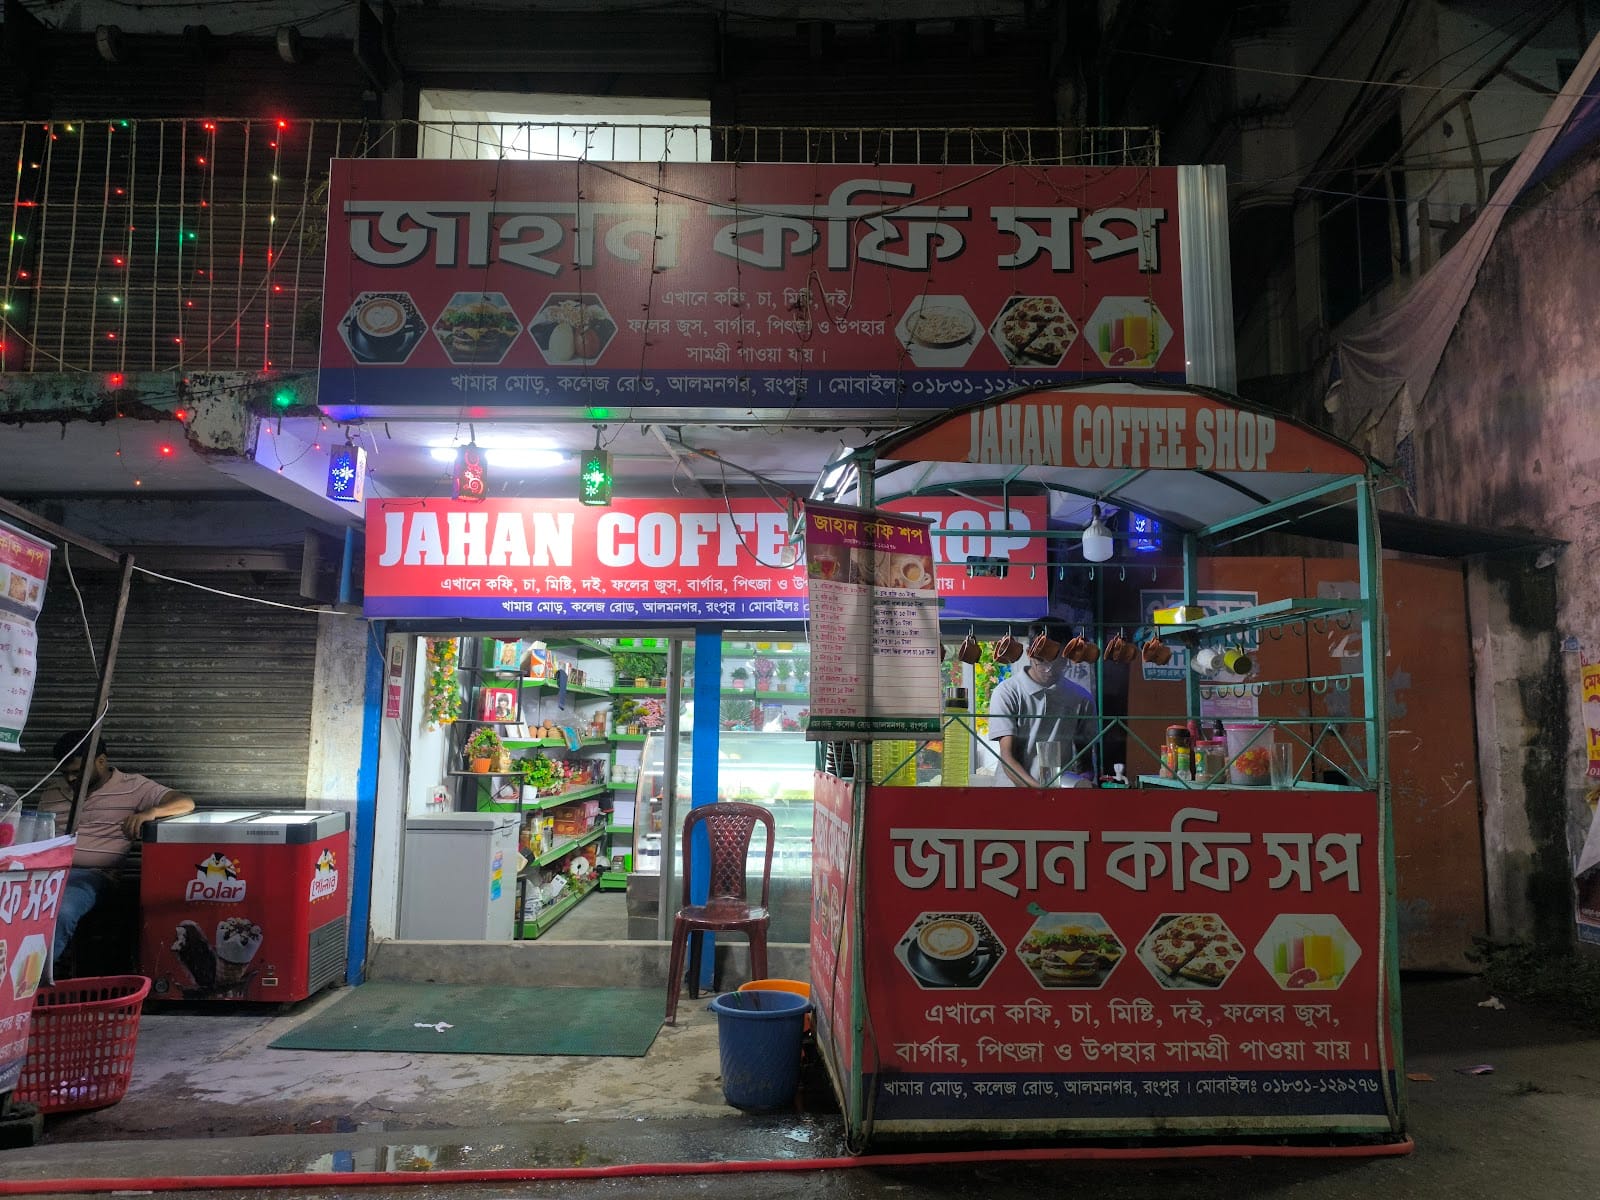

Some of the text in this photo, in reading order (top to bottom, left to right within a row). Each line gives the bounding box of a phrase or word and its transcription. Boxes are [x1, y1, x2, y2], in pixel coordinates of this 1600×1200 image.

[344, 179, 1166, 276] জাহান কফি সপ
[661, 289, 708, 305] এখানে
[757, 290, 777, 309] চা,
[824, 289, 853, 311] দই,
[676, 319, 708, 338] জুস,
[818, 321, 830, 334] ও
[836, 317, 885, 336] উপহার
[686, 343, 730, 363] সামগ্রী
[450, 374, 497, 392] খামার
[505, 373, 550, 396] মোড়,
[557, 374, 610, 393] কলেজ
[667, 376, 757, 397] আলমনগর,
[763, 376, 809, 395] রংপুর
[967, 402, 1277, 471] JAHAN COFFEE SHOP
[379, 512, 575, 567] JAHAN
[597, 512, 807, 568] COFFE
[813, 515, 858, 537] জাহান
[862, 518, 895, 541] কফি
[898, 526, 923, 545] শপ
[441, 577, 481, 591] এখানে
[486, 575, 518, 593] কফি,
[523, 578, 541, 593] চা,
[545, 575, 577, 594] মিষ্টি,
[581, 576, 606, 594] দই,
[611, 579, 649, 592] ফলের
[654, 579, 682, 595] জুস,
[686, 576, 728, 594] বার্গার,
[733, 575, 772, 592] পিৎজা
[777, 579, 788, 590] ও
[502, 601, 533, 613] খামার
[537, 601, 567, 615] মোড়,
[571, 601, 605, 613] কলেজ
[610, 601, 639, 615] রোড,
[643, 602, 702, 615] আলমনগর,
[705, 602, 736, 615] রংপুর
[750, 598, 799, 613] মোবাইলঃ
[890, 827, 1090, 898] জাহান
[1101, 807, 1251, 893] কফি
[1263, 832, 1362, 893] সপ
[189, 881, 243, 900] Polar
[925, 998, 1340, 1029] এখানে কফি, চা, মিষ্টি, দই, ফলের জুস,
[895, 1035, 968, 1067] বার্গার,
[977, 1036, 1043, 1064] পিৎজা
[1054, 1044, 1073, 1062] ও
[1081, 1037, 1156, 1064] উপহার
[1166, 1035, 1229, 1063] সামগ্রী
[1239, 1041, 1304, 1062] পাওয়া
[1315, 1041, 1352, 1062] যায়
[884, 1080, 923, 1096] খামার
[929, 1079, 968, 1098] মোড়,
[973, 1080, 1016, 1096] কলেজ
[1022, 1079, 1059, 1097] রোড,
[1064, 1079, 1138, 1097] আলমনগর,
[1142, 1080, 1179, 1098] রংপুর
[1195, 1074, 1257, 1095] মোবাইলঃ
[1262, 1078, 1379, 1095] ০১৮৩১-১২৯২৭৬
